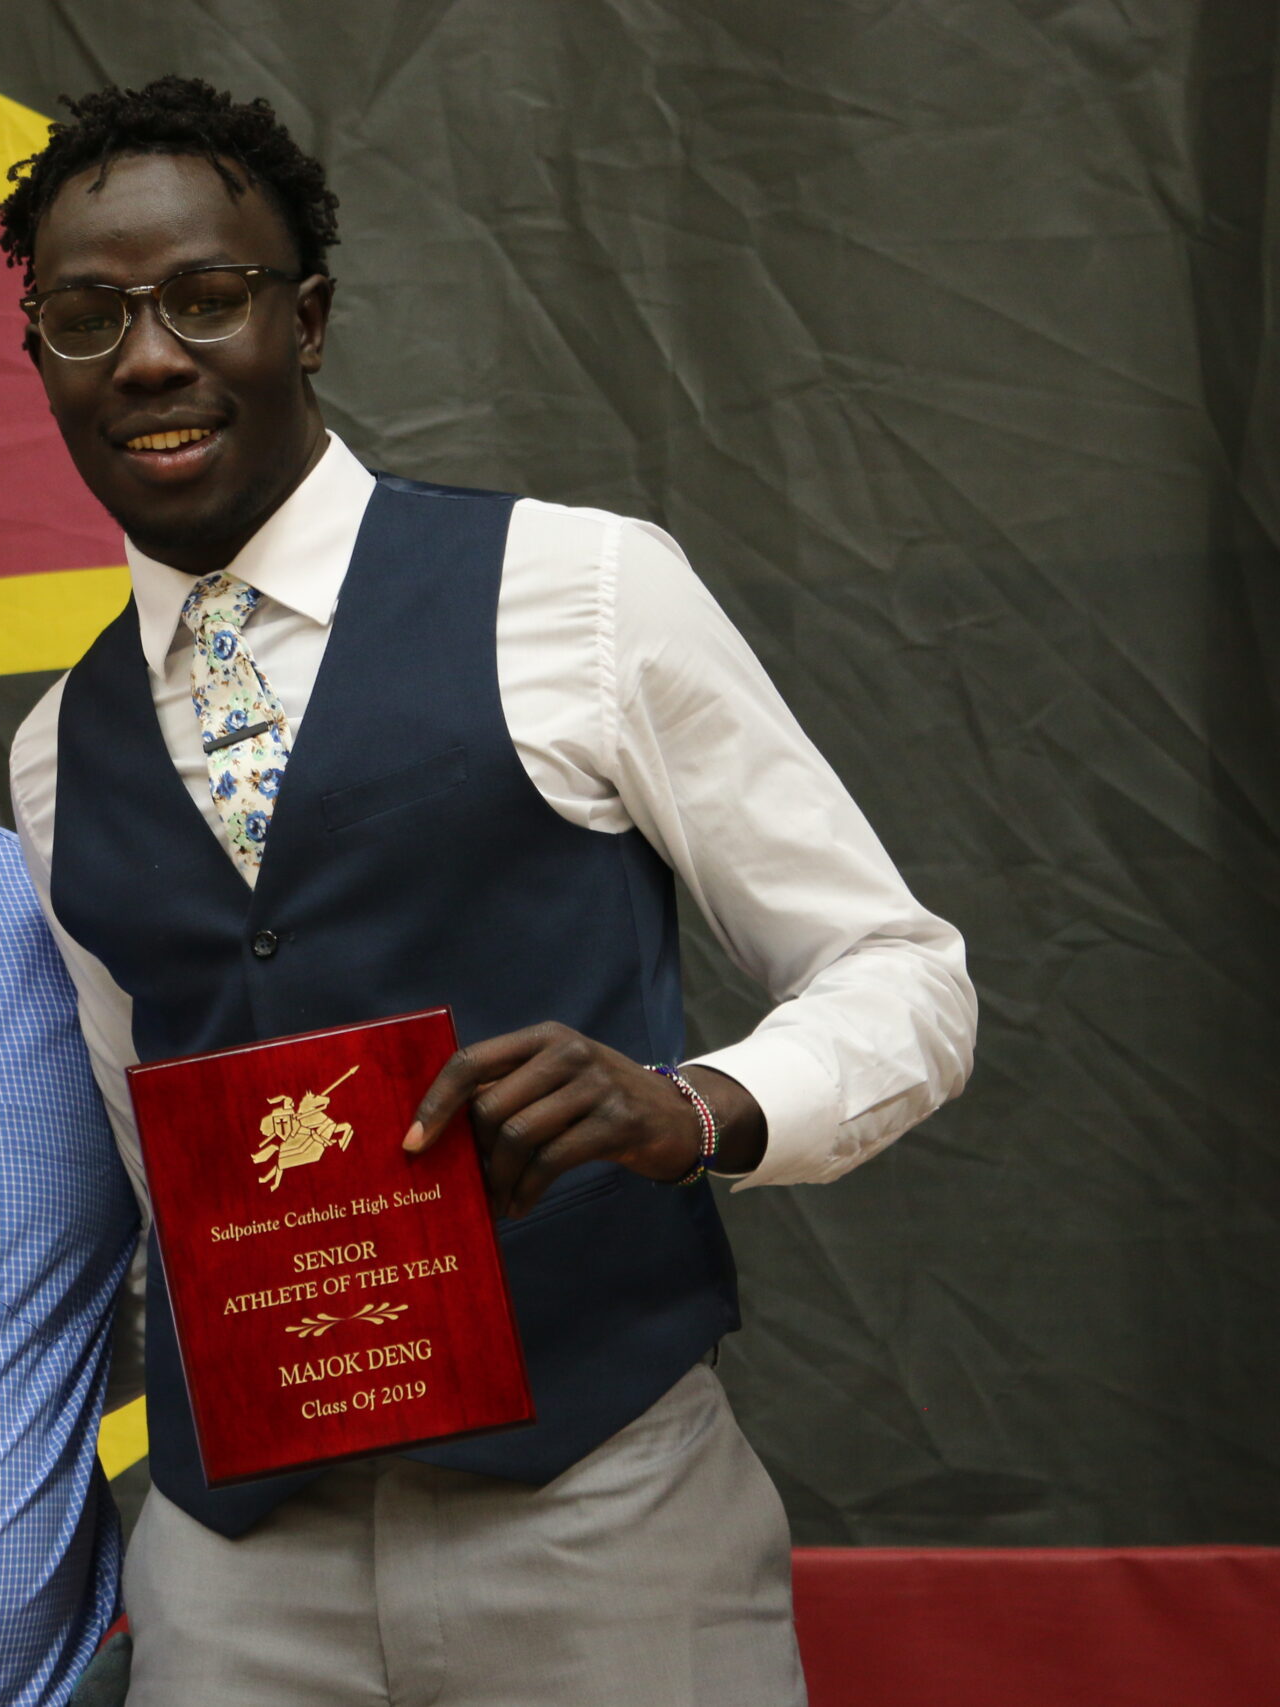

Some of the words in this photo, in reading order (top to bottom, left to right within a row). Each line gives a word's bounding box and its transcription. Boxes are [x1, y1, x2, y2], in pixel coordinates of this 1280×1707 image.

[211, 1219, 280, 1242] Salpointe
[284, 1204, 347, 1228] Catholic
[351, 1194, 389, 1216] High
[393, 1183, 442, 1208] School
[293, 1240, 378, 1273] SENIOR
[223, 1281, 319, 1315] ATHLETE
[322, 1275, 351, 1296] OF
[356, 1265, 400, 1289] THE
[402, 1255, 459, 1280] YEAR
[278, 1352, 363, 1387] MAJOK
[366, 1339, 432, 1370] DENG
[301, 1399, 348, 1420] Class
[352, 1389, 377, 1412] Of
[382, 1380, 427, 1405] 2019
